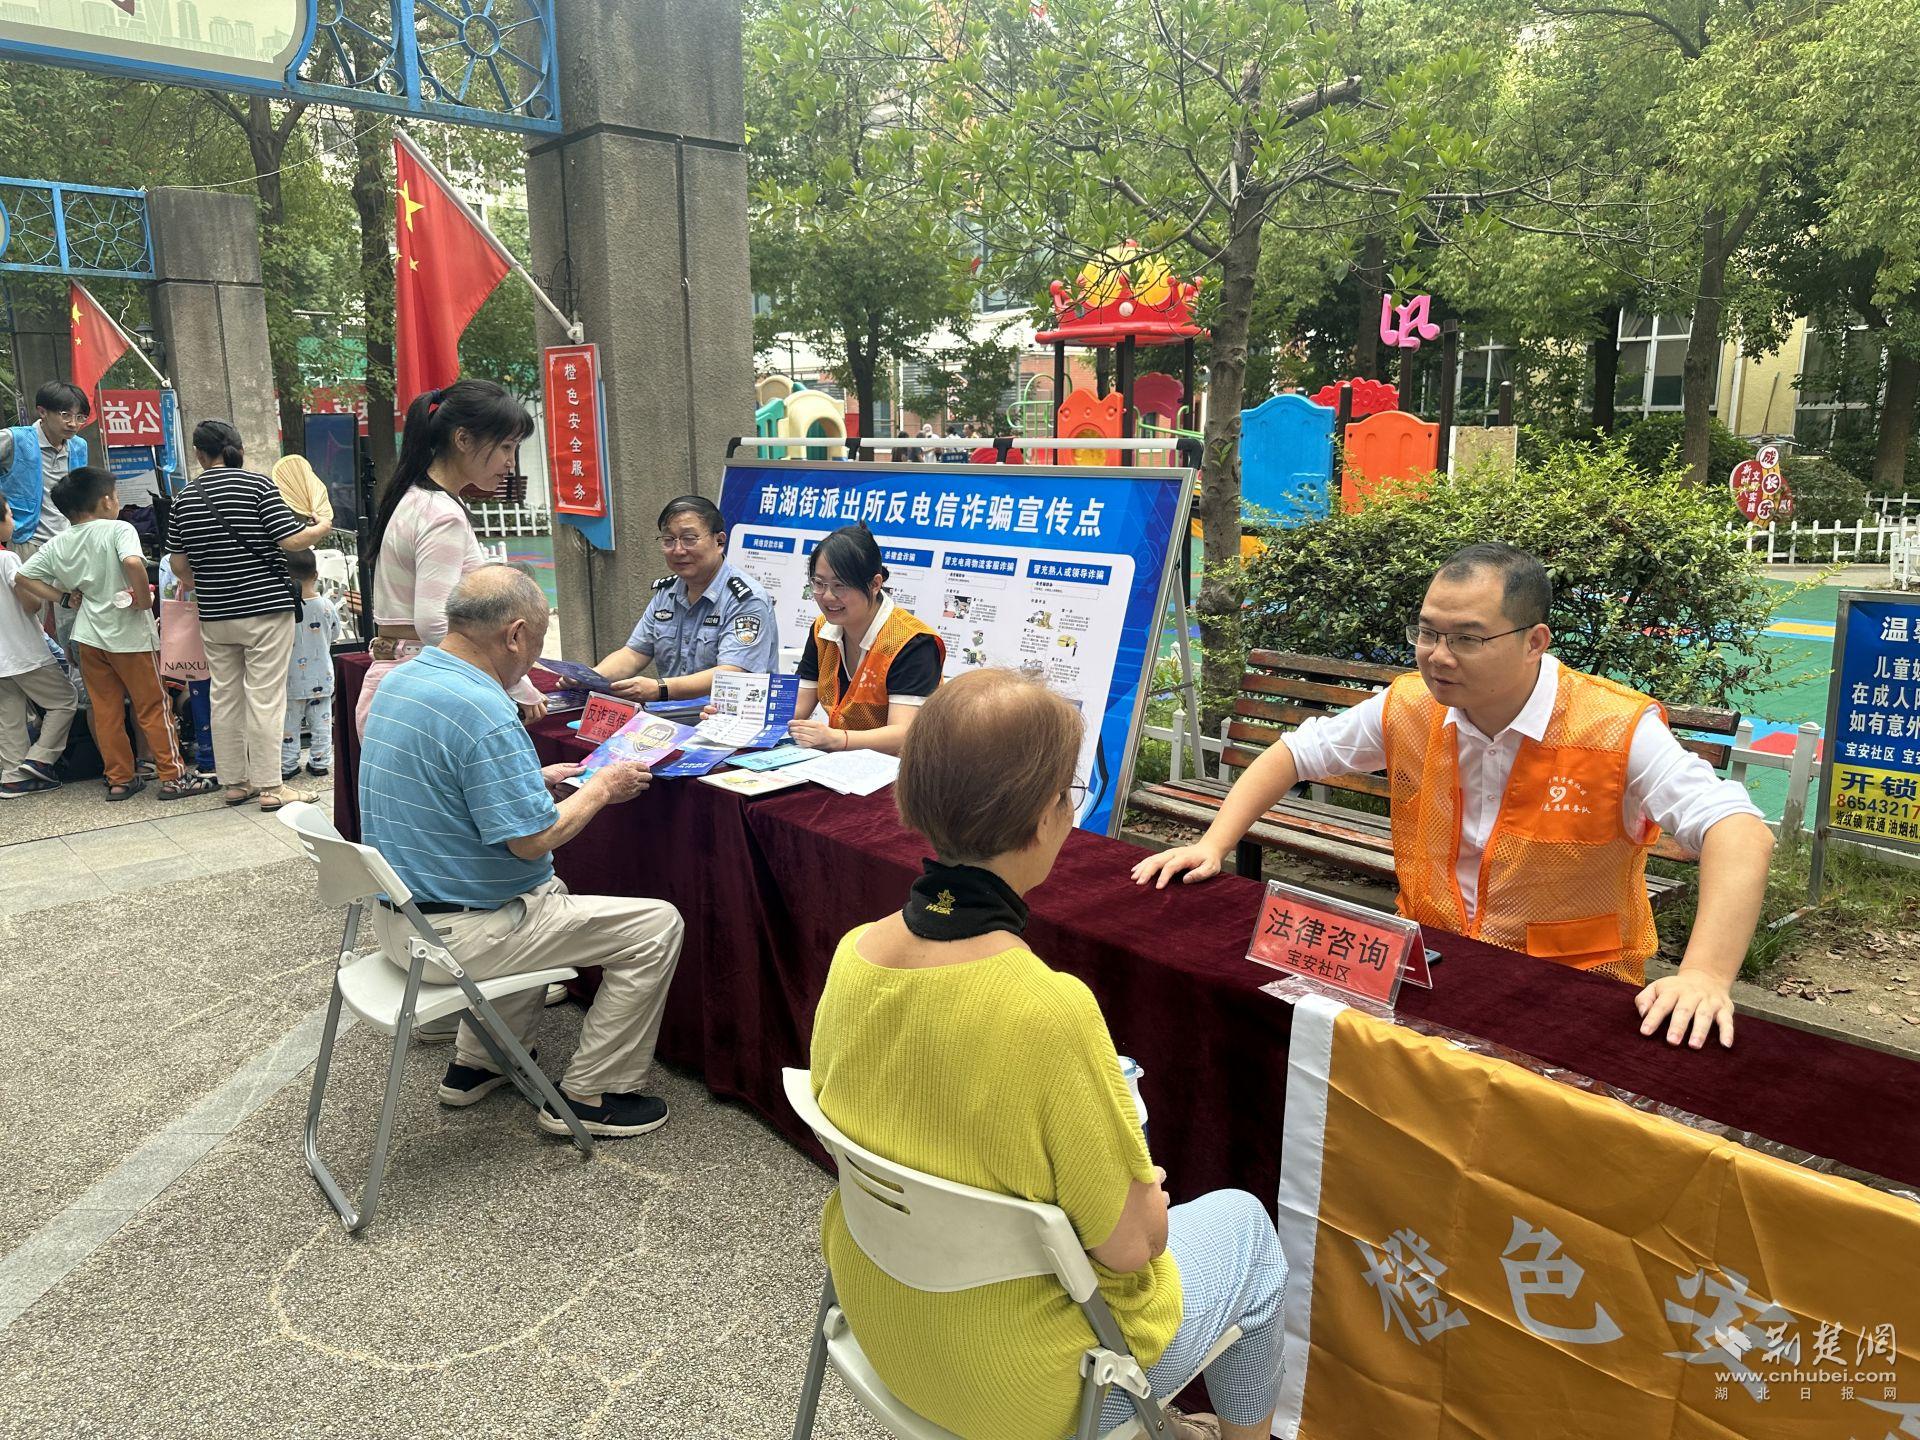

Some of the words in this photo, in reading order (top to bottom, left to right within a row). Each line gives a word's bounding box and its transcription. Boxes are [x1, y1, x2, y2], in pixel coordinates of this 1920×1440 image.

[564, 363, 586, 500] 橙色安全服务
[759, 484, 1105, 538] 南湖街派出所反电信诈骗宣传点
[164, 661, 211, 671] NAIXU
[1845, 742, 1895, 762] 宝安社区
[1841, 770, 1918, 801] 开锁
[1888, 819, 1920, 839] 油烟机
[1265, 907, 1390, 972] 法律咨询
[1285, 949, 1352, 983] 宝安社区
